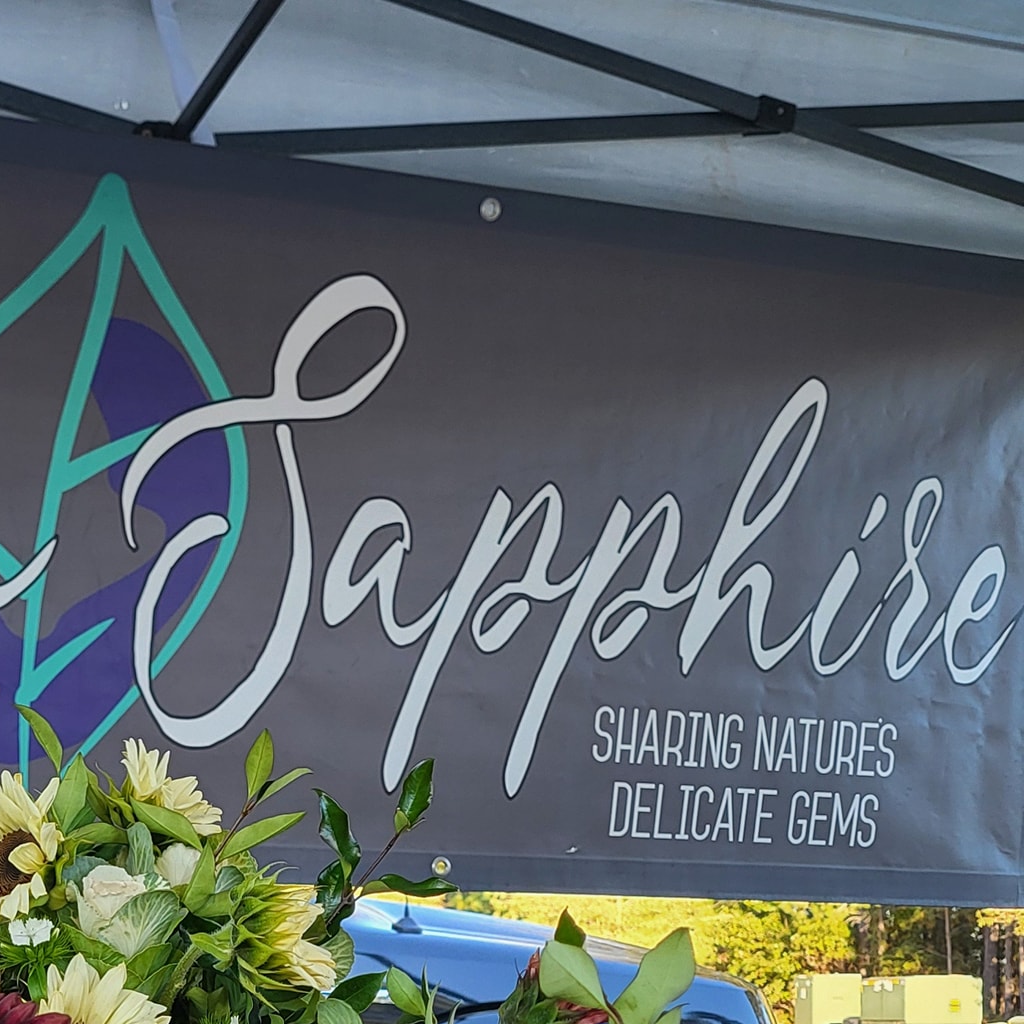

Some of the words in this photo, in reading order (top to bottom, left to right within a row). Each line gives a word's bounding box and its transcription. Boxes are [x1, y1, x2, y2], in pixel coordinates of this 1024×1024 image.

[121, 273, 1022, 799] Sapphire
[592, 705, 744, 770] SHARING
[608, 780, 779, 844] DELICATE
[787, 790, 881, 848] GEMS
